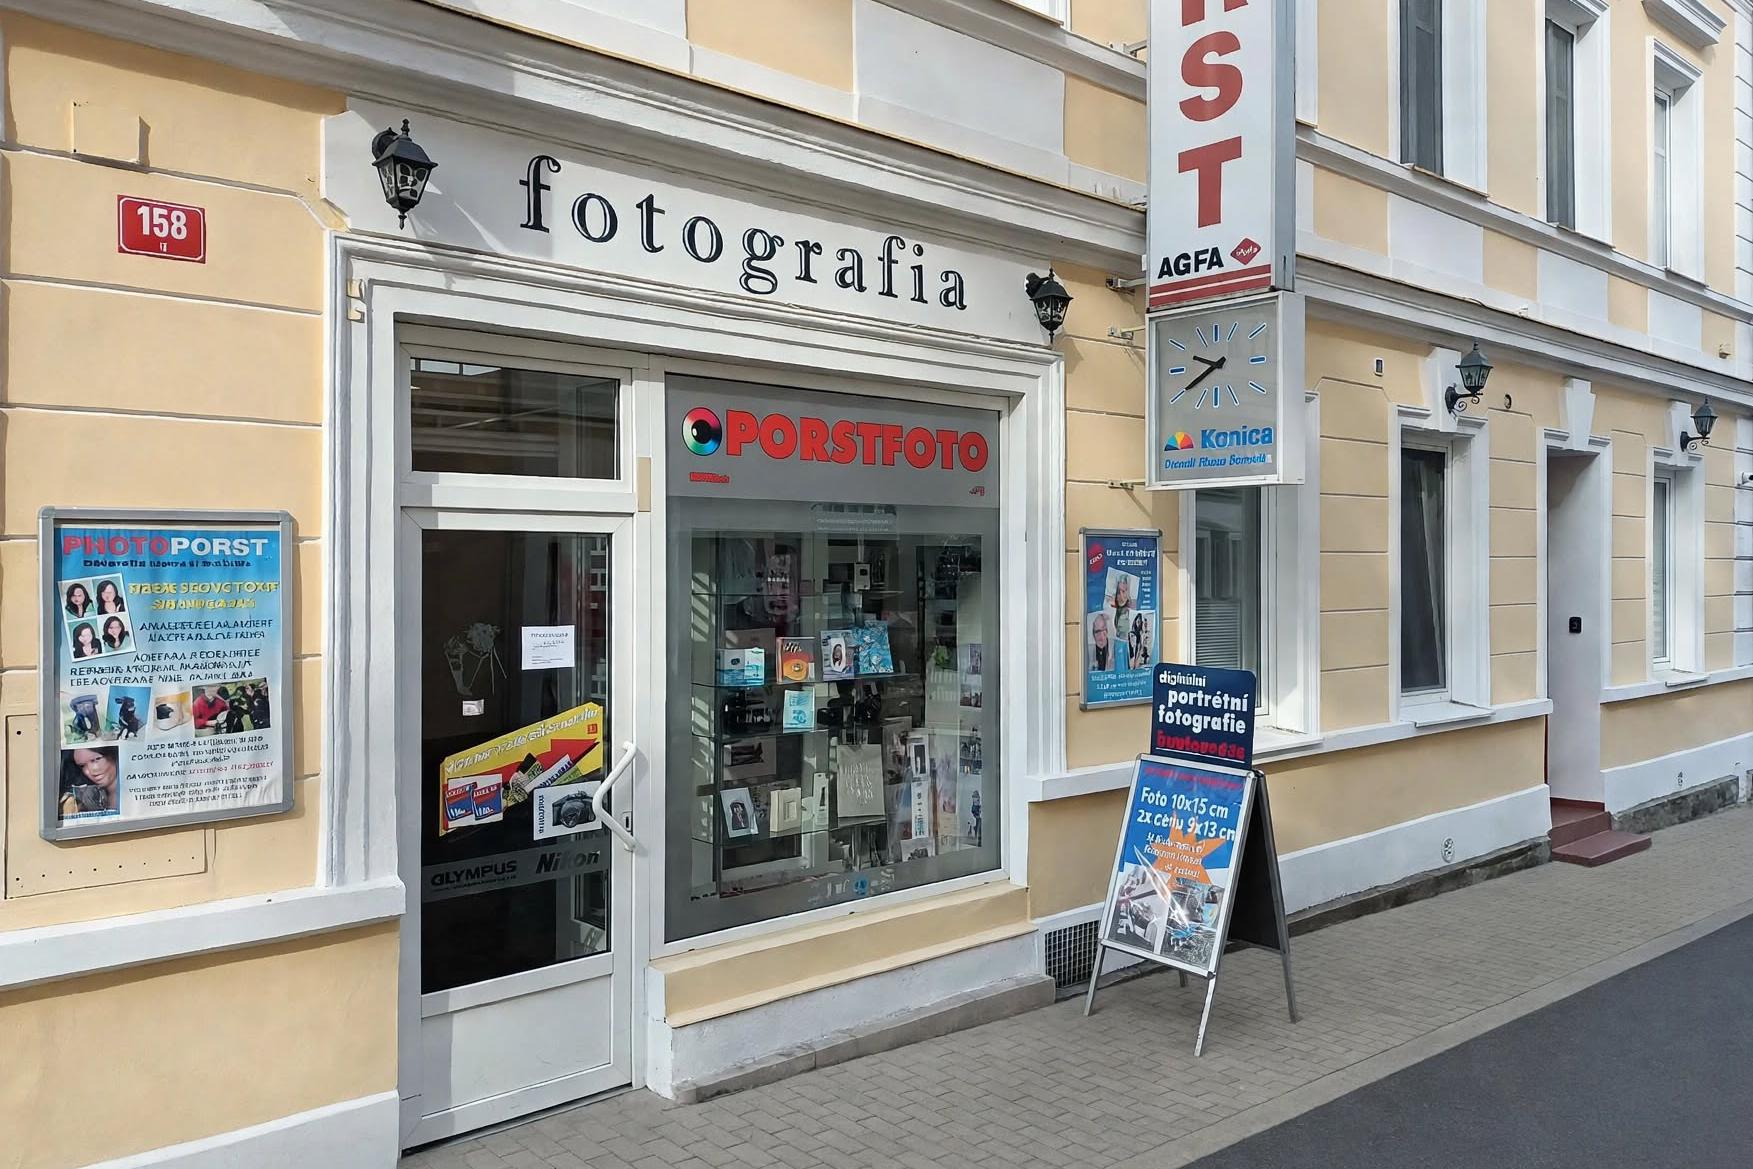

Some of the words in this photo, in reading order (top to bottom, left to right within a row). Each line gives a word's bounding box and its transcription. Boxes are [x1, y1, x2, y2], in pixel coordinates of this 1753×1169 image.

[137, 205, 187, 240] 158
[518, 154, 967, 310] fotografia
[1157, 247, 1224, 279] AGFA
[726, 409, 988, 472] PORSTFOTO
[1200, 425, 1273, 449] Konica
[62, 535, 269, 556] PHOTOPORST
[1167, 690, 1249, 712] portrétní
[1158, 704, 1246, 733] fotografie
[1140, 787, 1167, 807] Foto
[1171, 793, 1209, 815] 10x15
[1209, 804, 1228, 819] cm
[1137, 809, 1152, 824] 2x
[1187, 815, 1218, 838] 9x13
[536, 850, 600, 874] Nion
